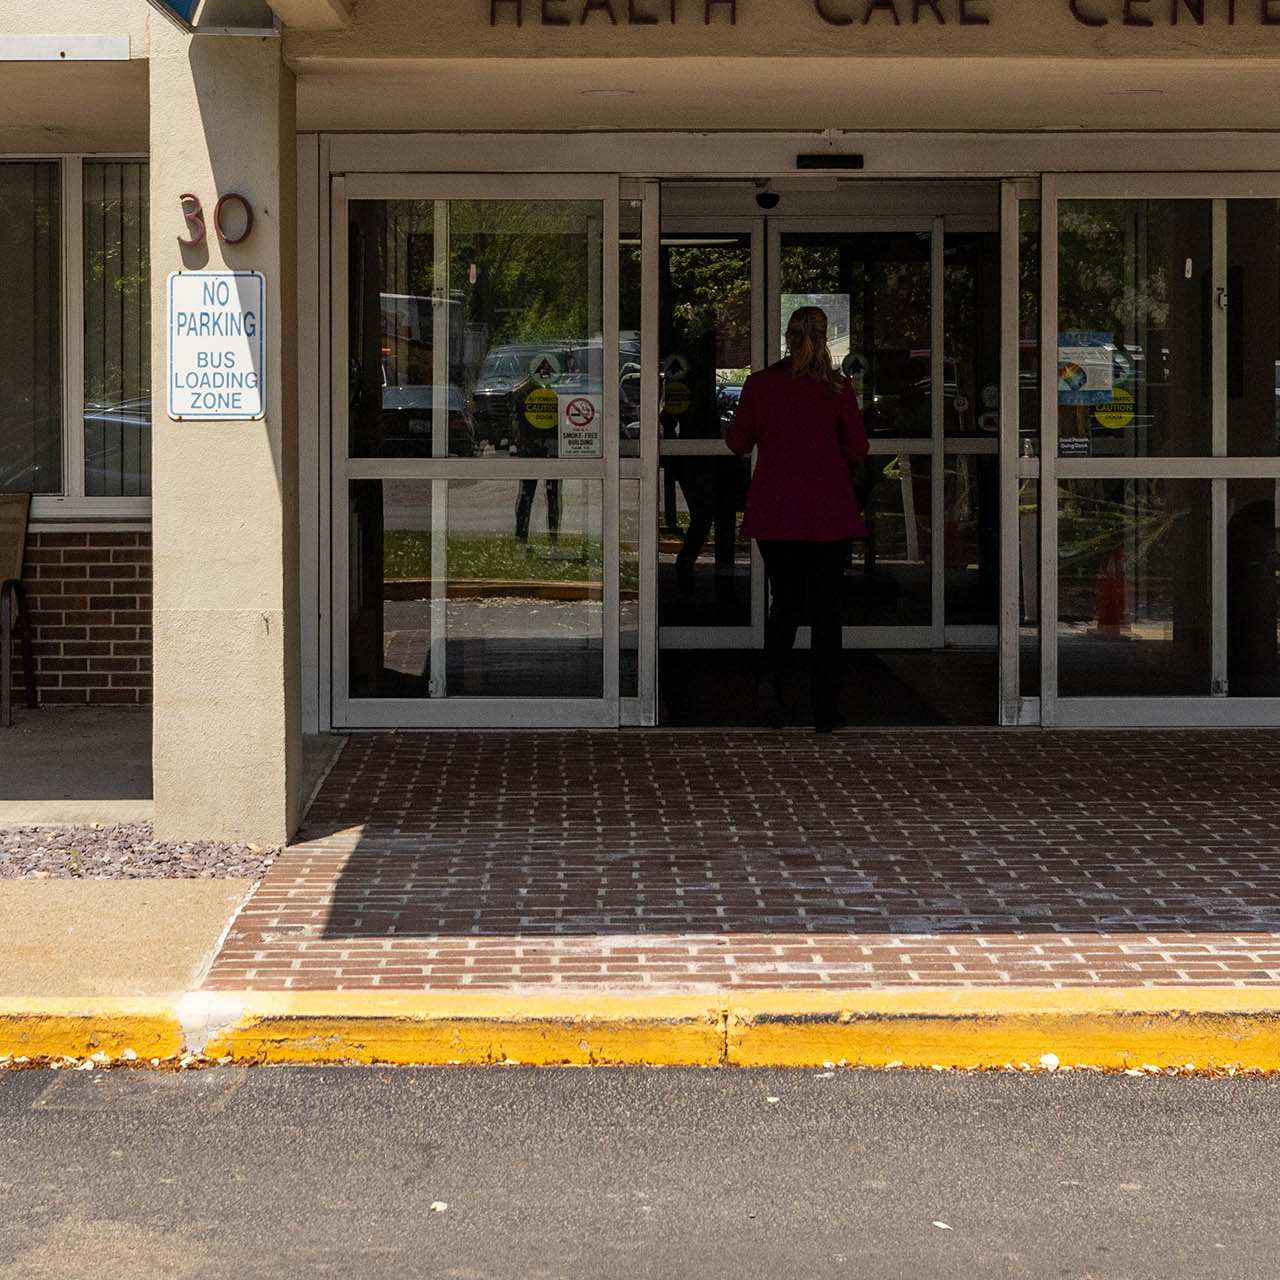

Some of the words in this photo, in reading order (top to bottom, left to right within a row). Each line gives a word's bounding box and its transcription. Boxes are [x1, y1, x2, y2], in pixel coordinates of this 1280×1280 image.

[176, 192, 254, 246] 30
[203, 280, 230, 307] NO
[176, 311, 257, 338] PARKING
[196, 351, 236, 369] BUS
[174, 371, 259, 389] LOADING
[190, 392, 243, 410] ZONE
[527, 404, 558, 412] CAUTIO
